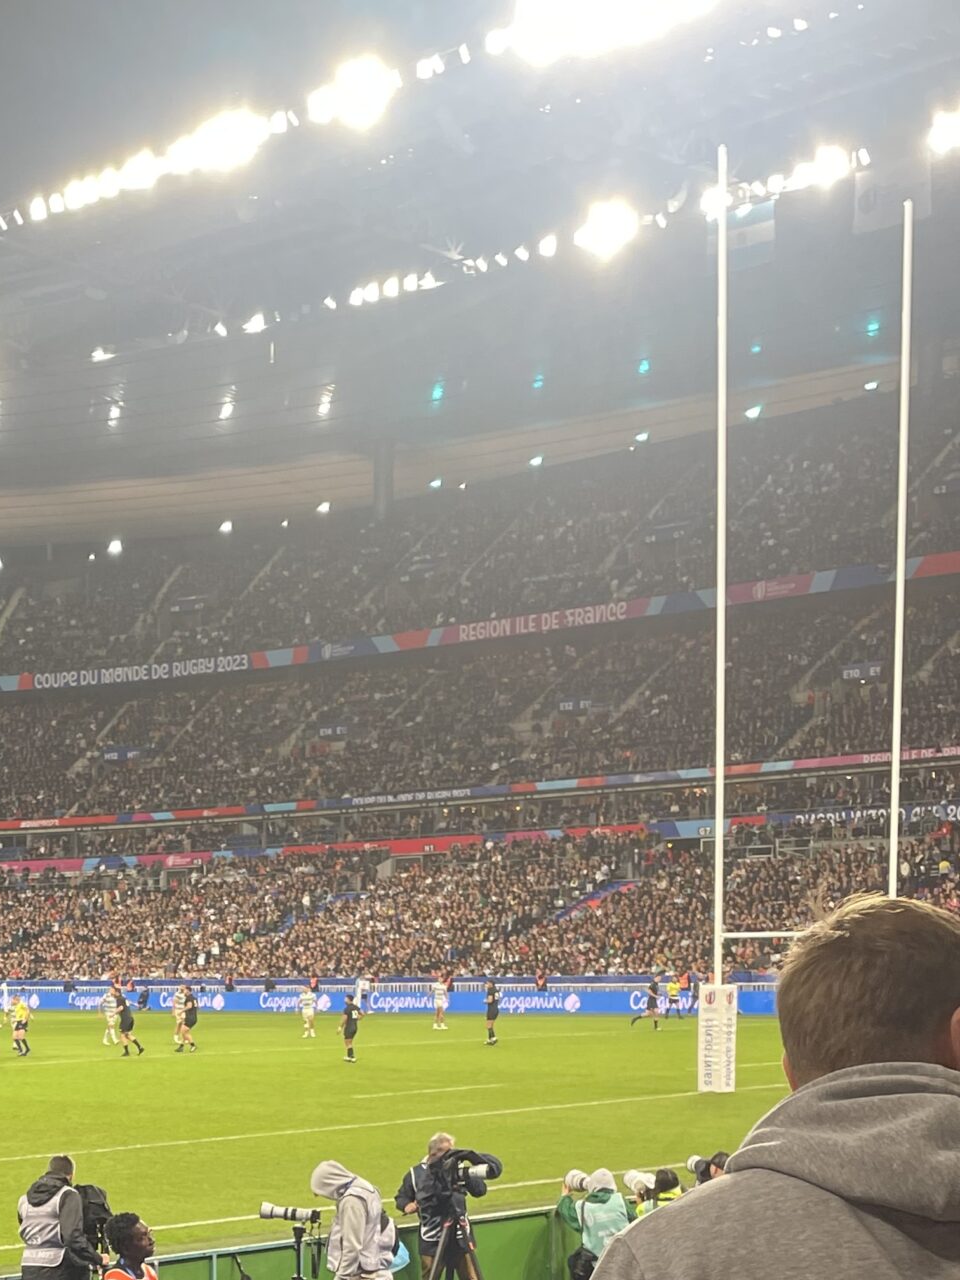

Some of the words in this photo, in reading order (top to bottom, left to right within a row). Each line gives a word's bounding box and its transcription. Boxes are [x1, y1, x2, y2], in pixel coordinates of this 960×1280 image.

[459, 618, 511, 642] REGION
[515, 614, 537, 635] ILE
[541, 611, 561, 631] DE
[34, 672, 79, 689] COUPE
[80, 670, 98, 686] DU
[101, 665, 149, 684] MONDE
[151, 663, 170, 680] DE
[172, 657, 215, 678] RUGBY
[216, 654, 249, 672] 2023
[370, 991, 434, 1013] Capgemini
